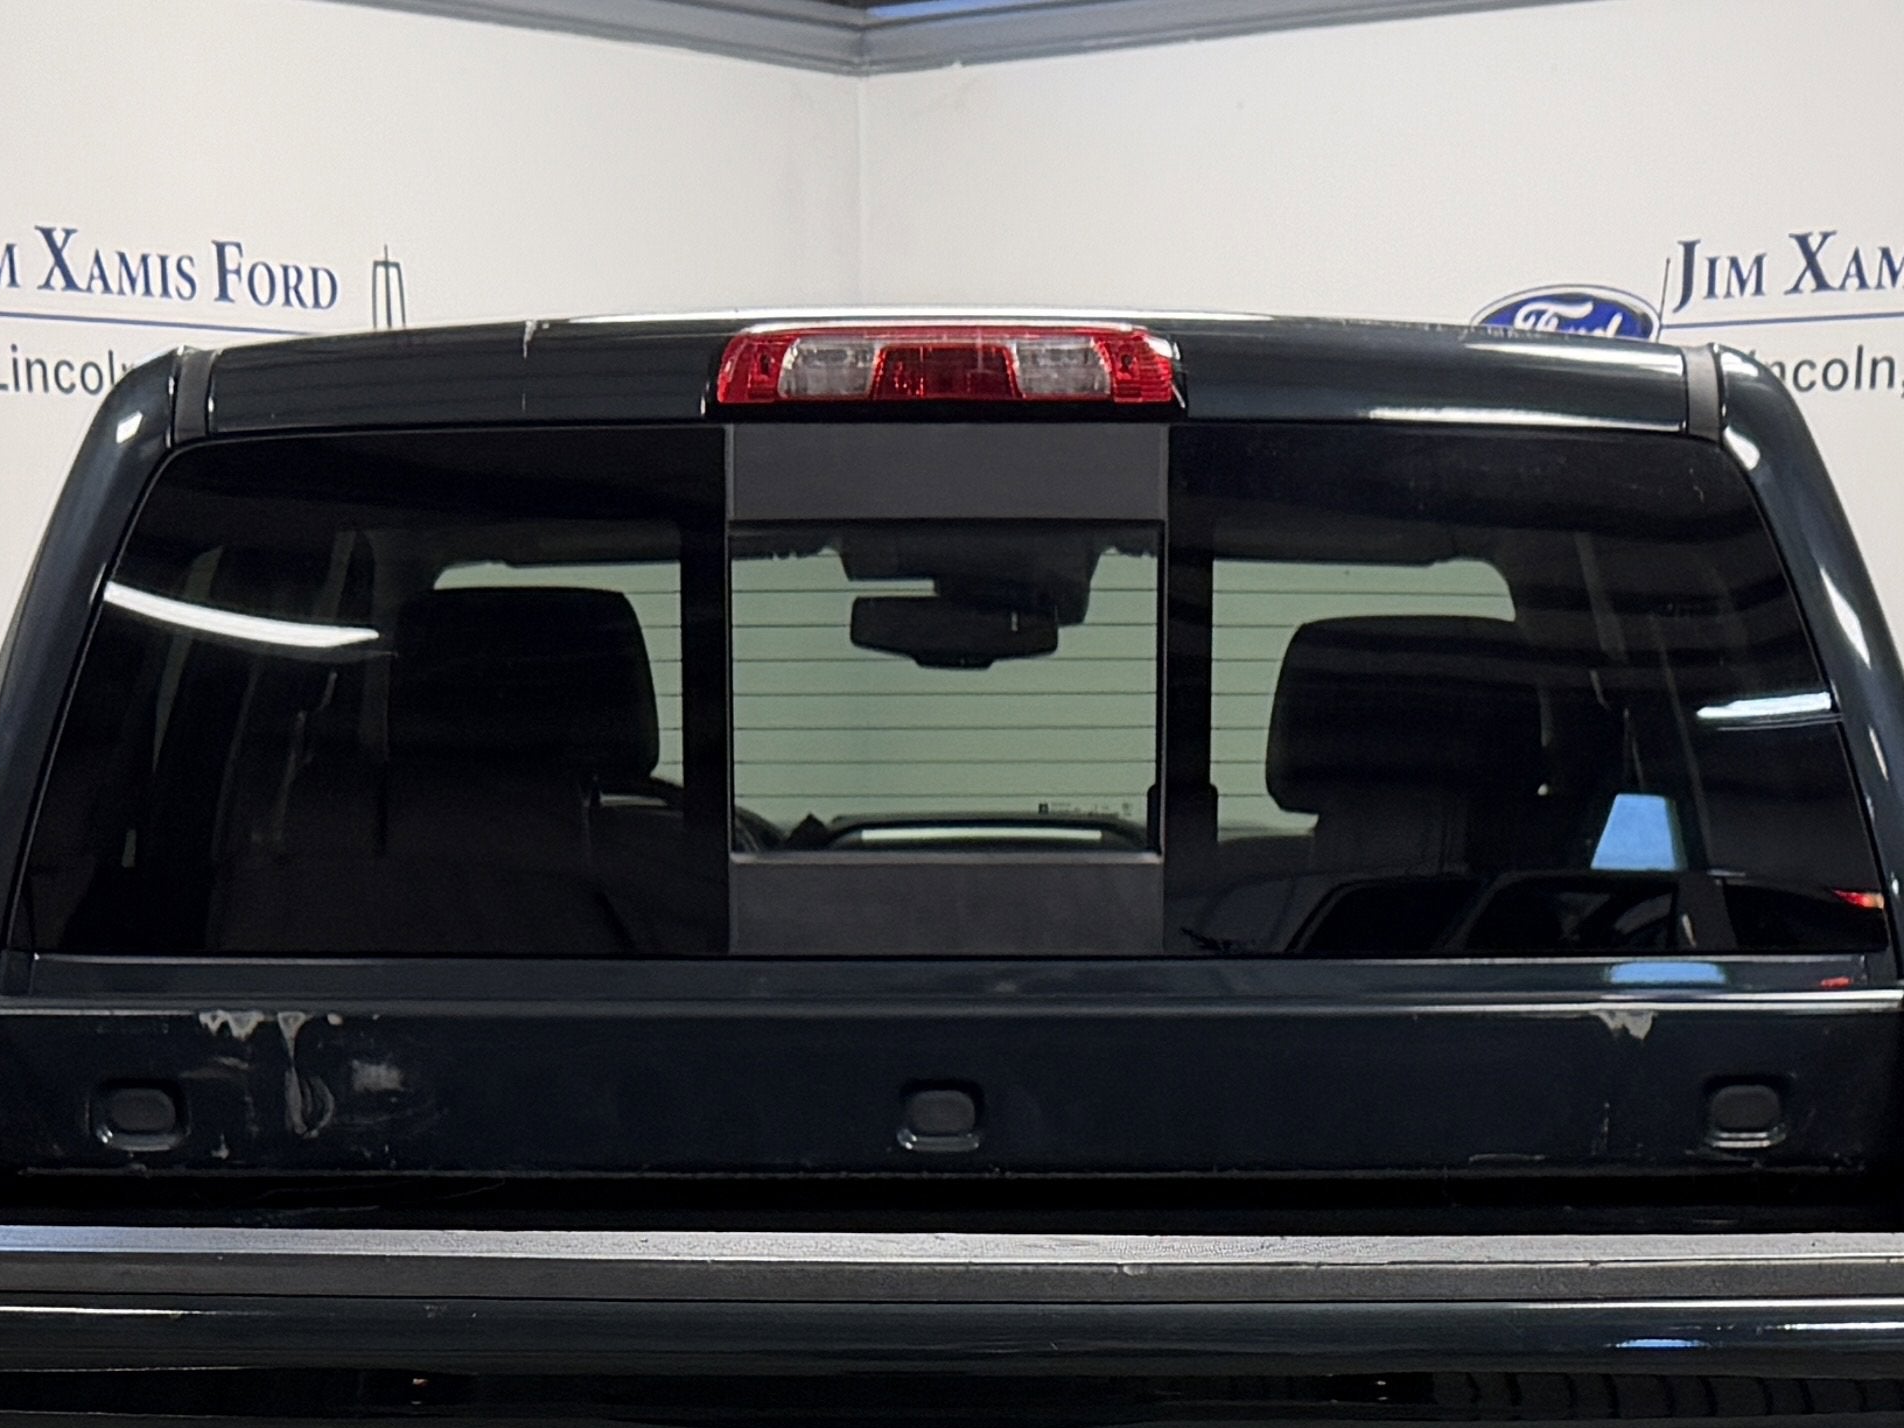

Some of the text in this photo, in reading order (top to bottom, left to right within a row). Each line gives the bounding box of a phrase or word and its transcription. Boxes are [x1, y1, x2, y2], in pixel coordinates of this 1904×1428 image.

[34, 226, 197, 301] XAMIS
[210, 240, 338, 311] FORD
[1672, 238, 1767, 314] JIM
